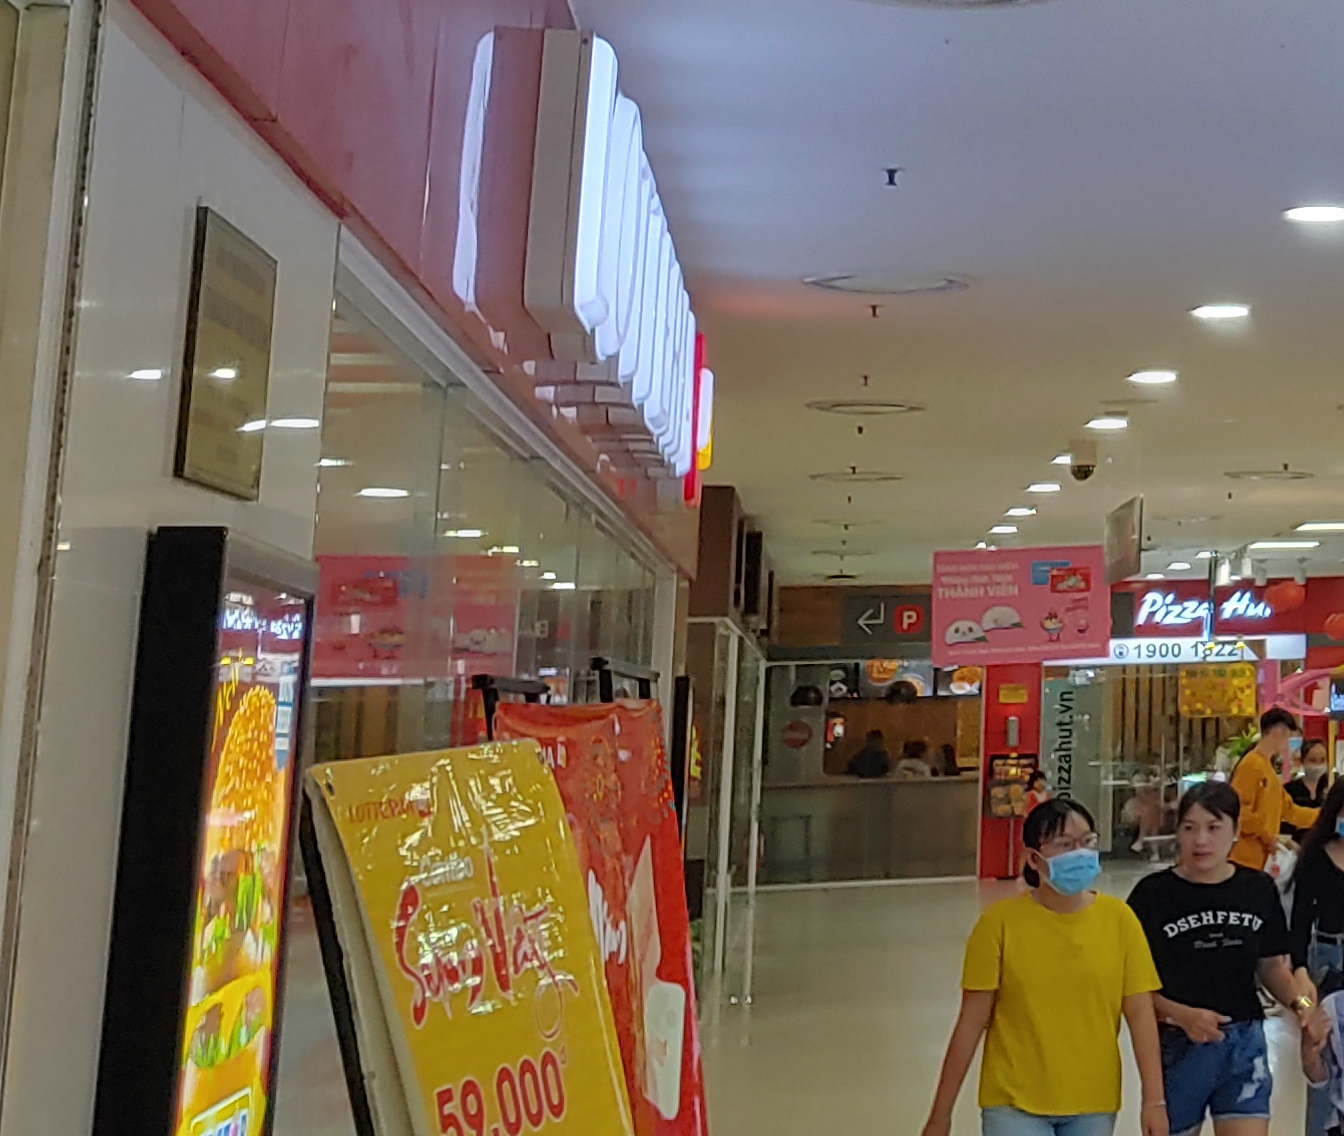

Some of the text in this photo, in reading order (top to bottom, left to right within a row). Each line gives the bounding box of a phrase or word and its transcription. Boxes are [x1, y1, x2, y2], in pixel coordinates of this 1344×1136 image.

[1219, 590, 1273, 620] Hu
[902, 610, 918, 630] P
[1133, 642, 1182, 659] 1900
